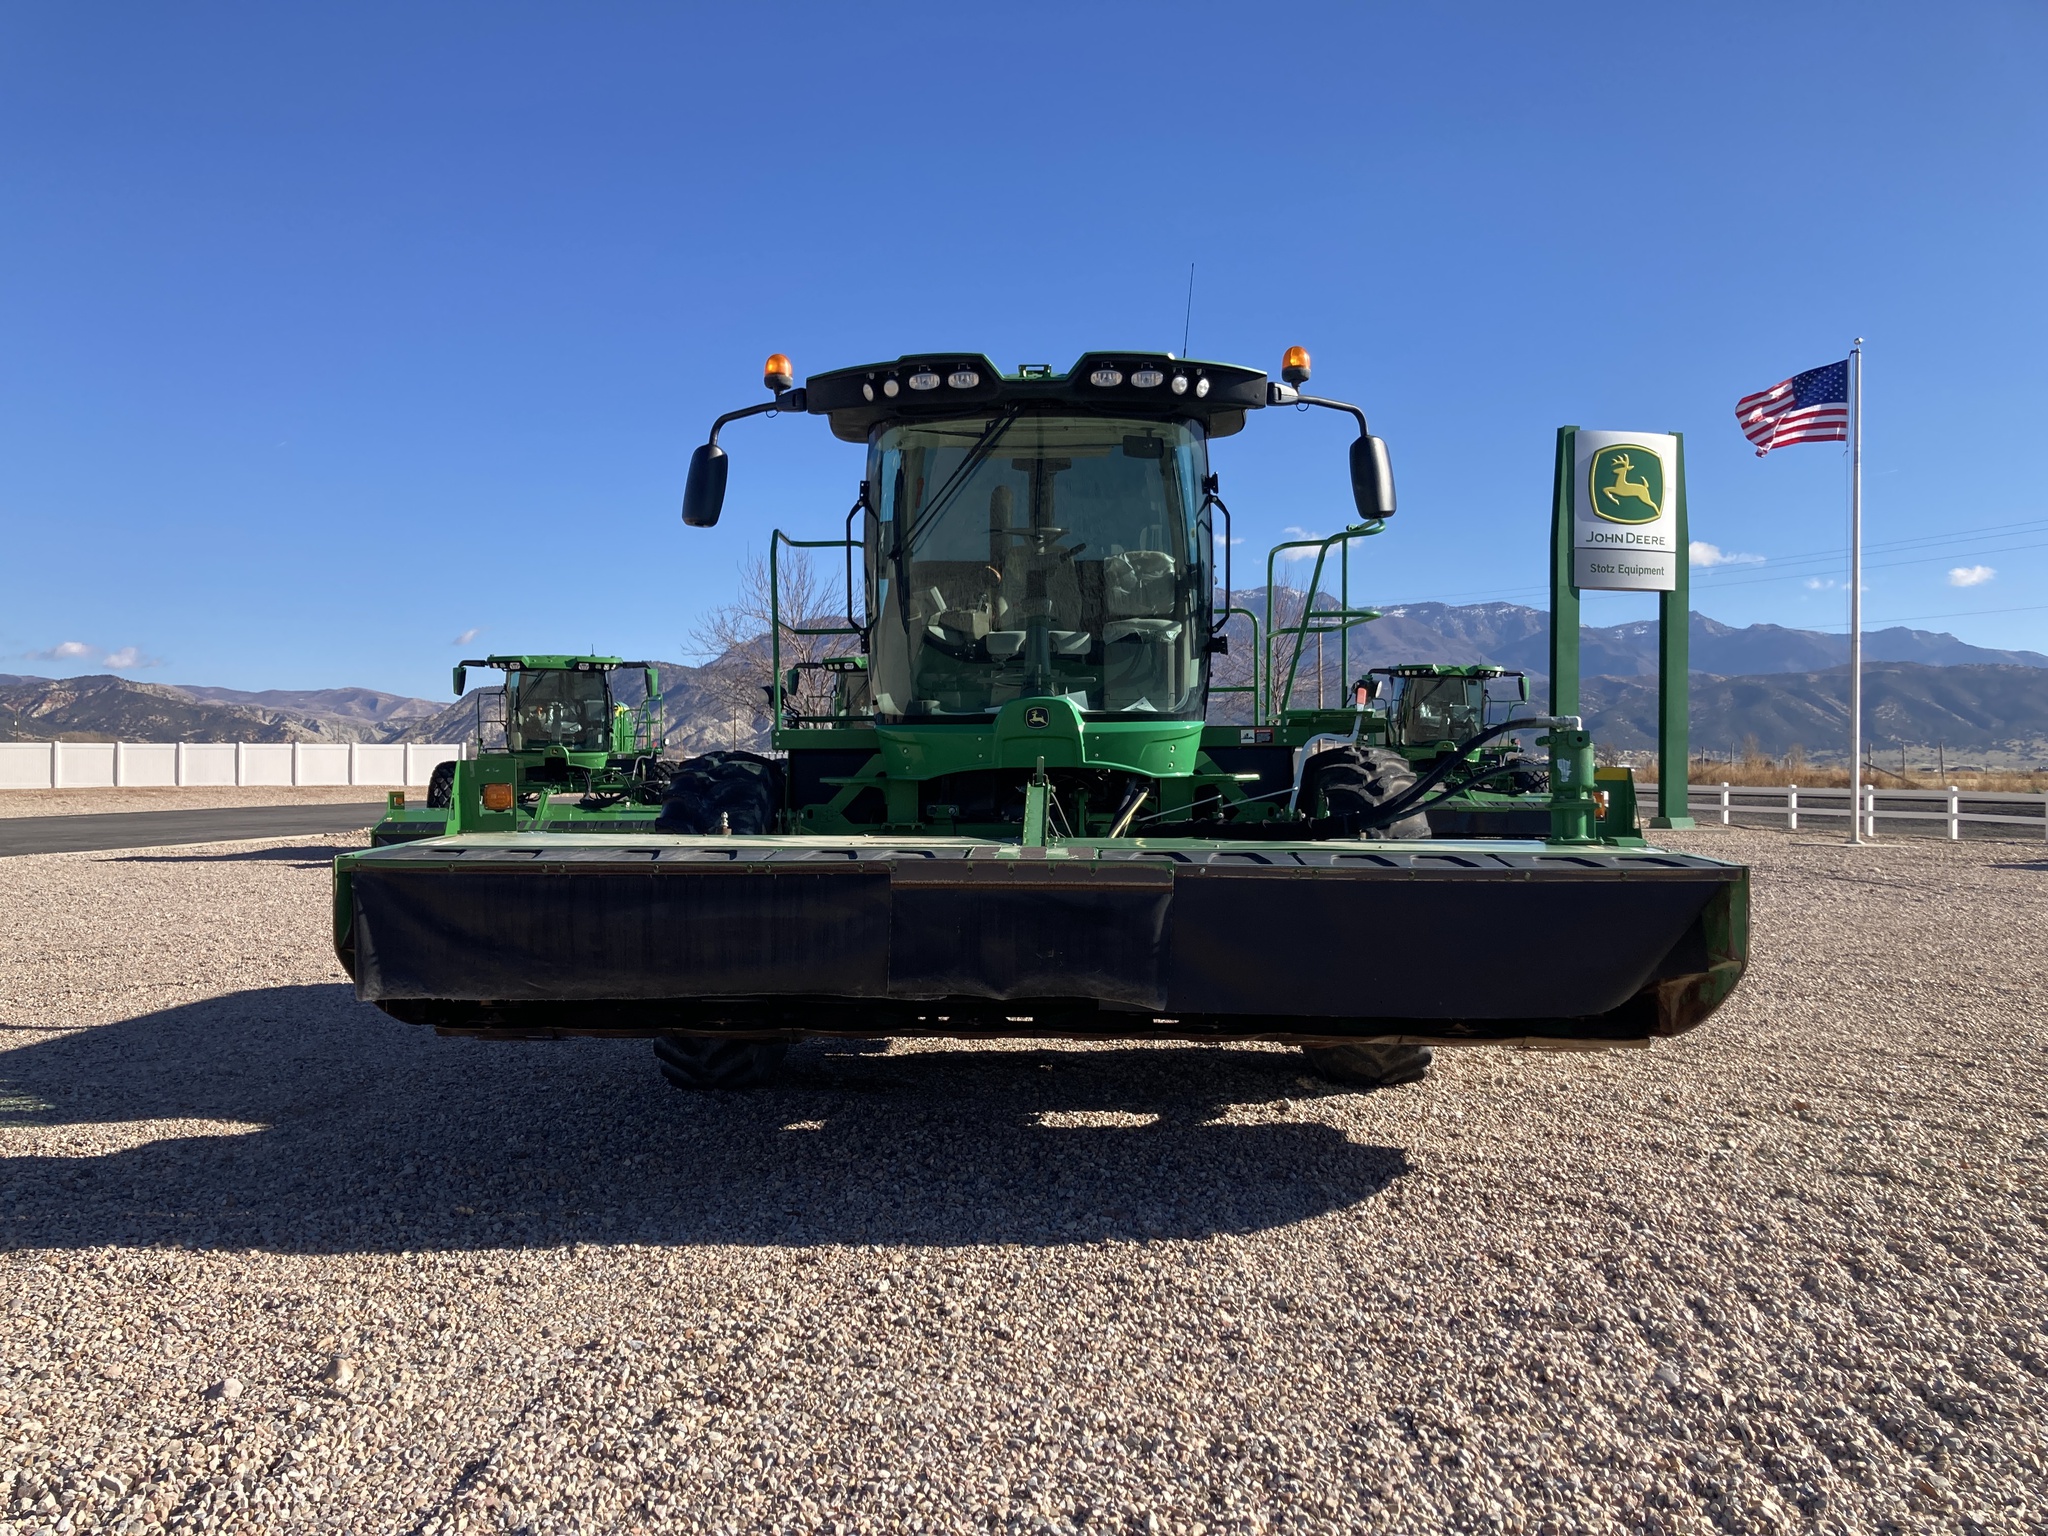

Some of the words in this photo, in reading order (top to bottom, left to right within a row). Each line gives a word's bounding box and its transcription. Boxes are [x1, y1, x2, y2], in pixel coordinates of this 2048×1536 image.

[1585, 531, 1624, 544] JOHN
[1626, 532, 1666, 546] DEERE
[1590, 563, 1615, 574] Stotz
[1618, 564, 1665, 576] Equipment
